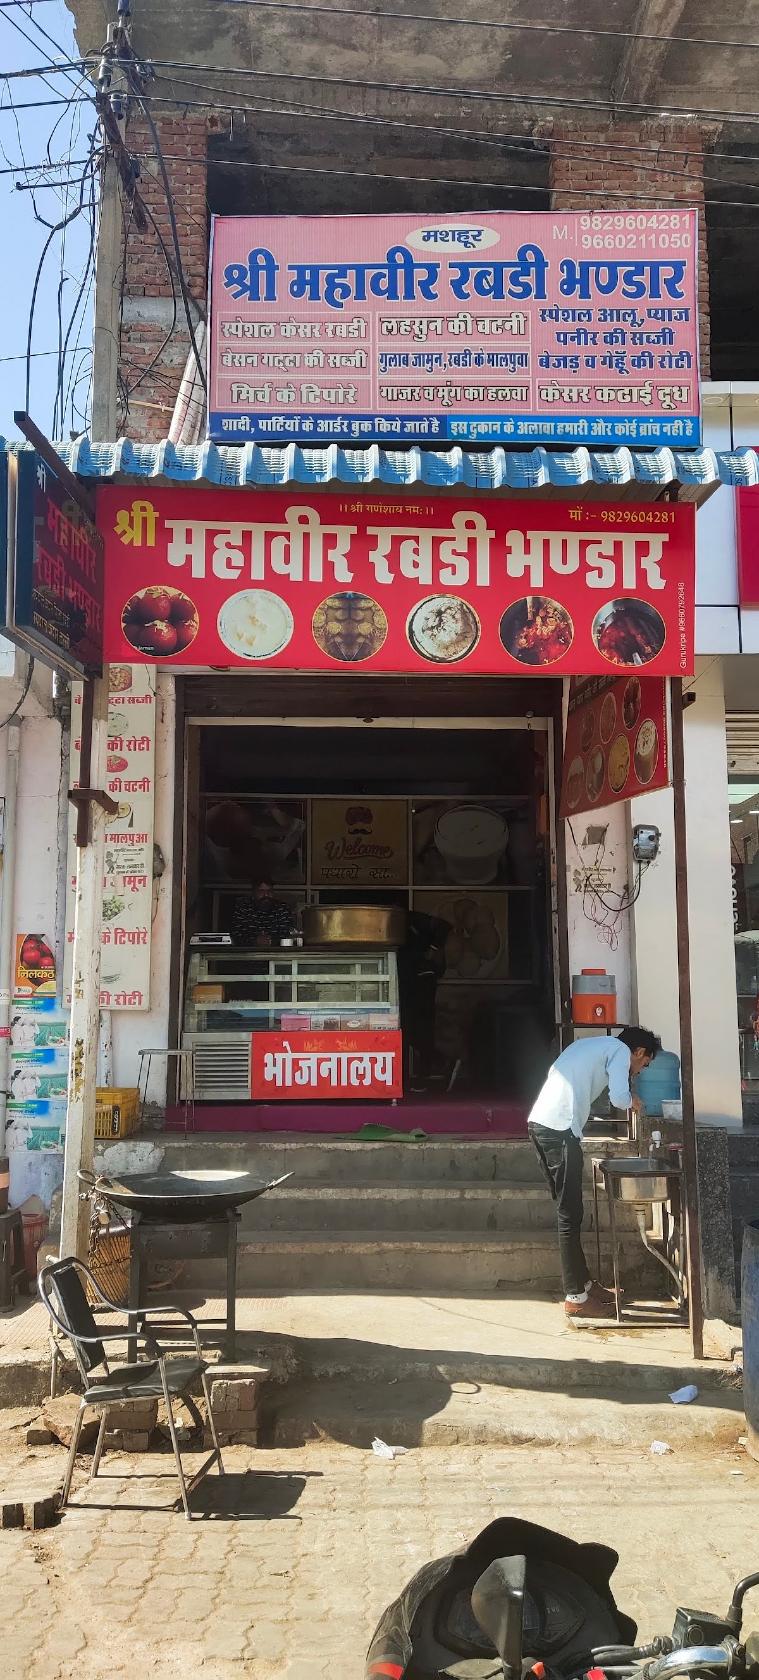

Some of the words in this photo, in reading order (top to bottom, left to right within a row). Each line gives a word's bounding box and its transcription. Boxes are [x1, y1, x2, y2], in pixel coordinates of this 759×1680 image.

[580, 214, 691, 230] 9829604281
[422, 228, 484, 248] मशहूर
[581, 233, 692, 249] 9660211050
[223, 247, 280, 303] श्री
[287, 245, 441, 309] महावीर
[448, 243, 549, 302] रबडी
[559, 258, 687, 301] भण्डार
[539, 304, 593, 322] स्पेशल
[221, 316, 276, 338] स्पेशल
[280, 316, 322, 338] केसर
[325, 317, 367, 338] रबडी
[380, 317, 444, 342] लहसुन
[446, 312, 473, 335] की
[476, 312, 527, 335] चटनी
[556, 328, 599, 346] पनीर
[603, 327, 627, 346] की
[631, 327, 675, 346] सब्जी
[221, 348, 258, 367] बेसन
[304, 350, 325, 367] की
[328, 349, 368, 368] सब्जी
[379, 352, 409, 372] गुलाब
[474, 349, 484, 368] के
[487, 353, 528, 372] मालपुवा
[538, 351, 580, 373] बेजड़
[584, 356, 597, 369] व
[631, 351, 655, 369] की
[658, 351, 693, 369] रोटी
[231, 382, 272, 403] मिर्च
[275, 384, 296, 403] के
[299, 383, 358, 404] टिपोरे
[380, 385, 421, 401] गाजर
[423, 386, 435, 401] व
[436, 381, 462, 407] मूंग
[464, 386, 485, 401] का
[487, 386, 528, 401] हलवा
[538, 380, 591, 404] केसर
[657, 386, 689, 410] दूध
[222, 416, 254, 434] शादी,
[258, 416, 301, 431] पार्टियों
[302, 417, 314, 432] के
[317, 417, 349, 432] आर्डर
[351, 420, 372, 437] बुक
[375, 417, 401, 433] किये
[450, 422, 467, 434] इस
[469, 421, 501, 438] दुकान
[503, 419, 514, 434] के
[517, 421, 555, 435] अलावा
[557, 419, 587, 435] हमारी
[590, 419, 612, 435] और
[615, 419, 637, 437] कोई
[350, 502, 363, 513] श्री
[600, 510, 675, 523] 9829604281
[113, 500, 159, 547] श्री
[164, 505, 357, 583] महावीर
[366, 510, 496, 587] रबडी
[505, 529, 669, 590] भण्डार
[127, 695, 152, 704] सब्जी
[107, 736, 123, 751] की
[126, 736, 151, 751] रोटी
[108, 778, 122, 792] की
[124, 777, 150, 792] चटनी
[109, 834, 148, 846] मालपुआ
[324, 836, 394, 861] Welcome
[114, 927, 148, 945] टिपोरे
[114, 991, 143, 1007] रोटी
[264, 1040, 396, 1087] भोजनालय
